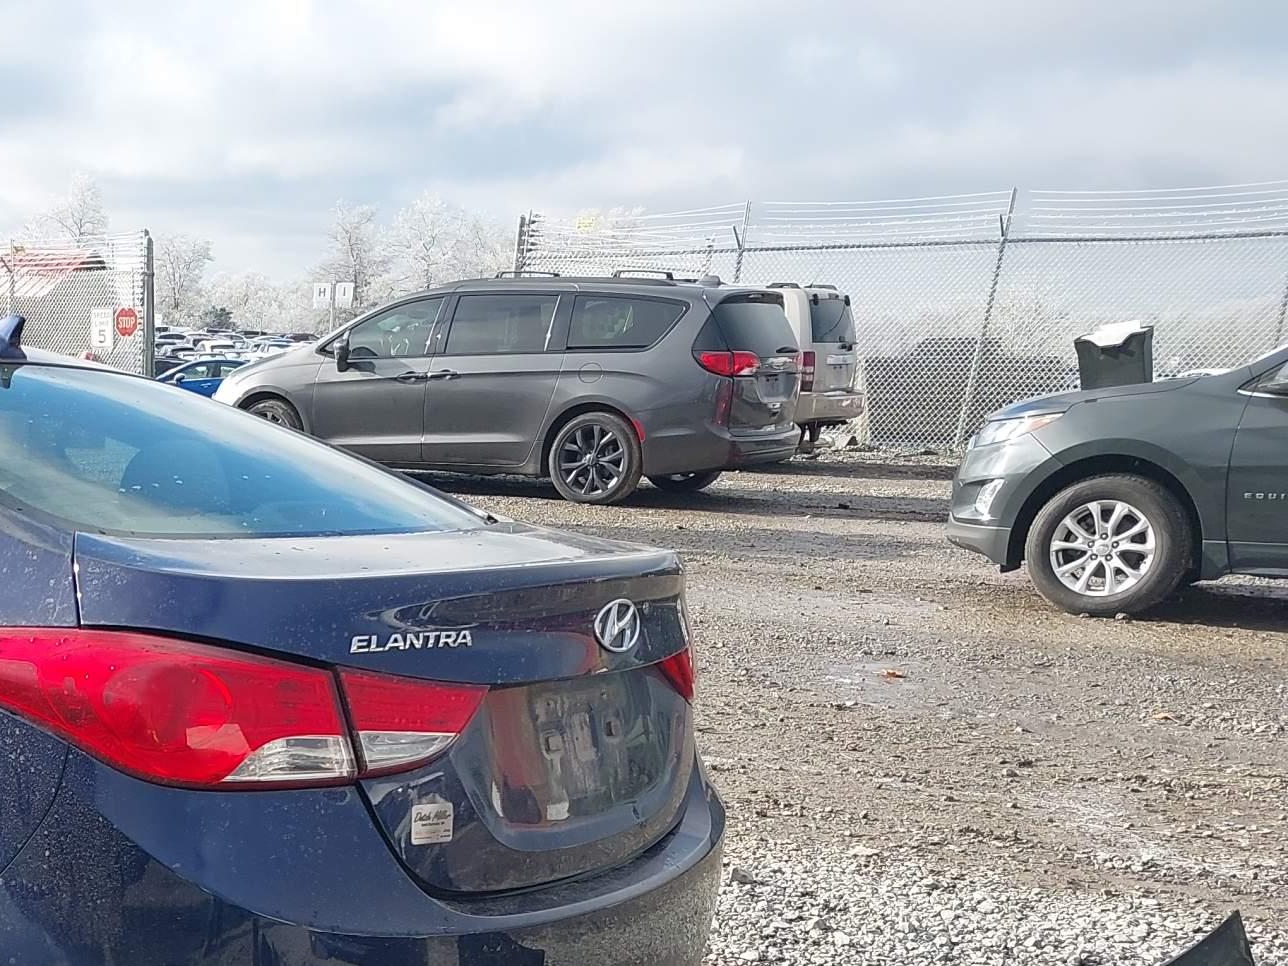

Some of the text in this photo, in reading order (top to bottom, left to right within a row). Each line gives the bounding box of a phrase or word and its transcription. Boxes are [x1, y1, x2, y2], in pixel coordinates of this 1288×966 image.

[318, 287, 327, 297] H
[118, 316, 136, 329] STOP
[98, 329, 107, 344] 5
[349, 629, 473, 654] ELANTRA
